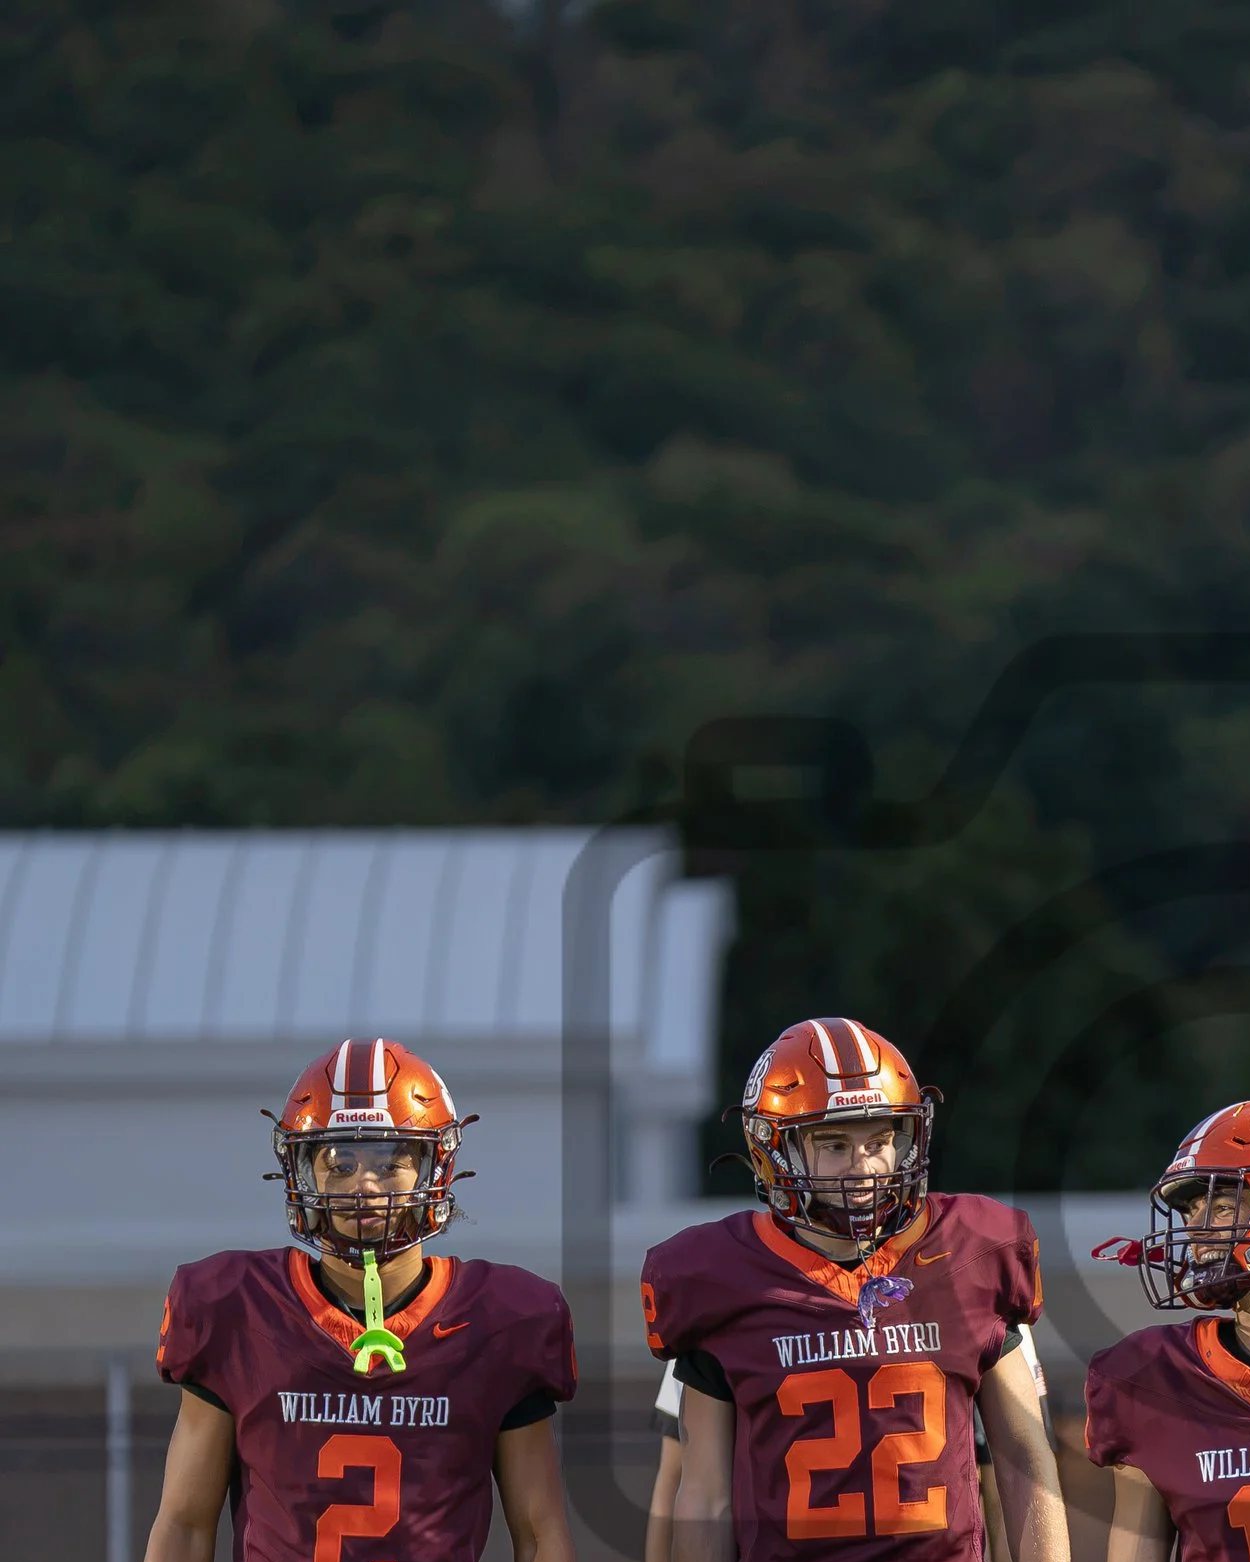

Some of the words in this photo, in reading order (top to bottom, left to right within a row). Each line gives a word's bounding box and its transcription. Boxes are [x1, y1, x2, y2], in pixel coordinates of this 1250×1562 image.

[835, 1092, 882, 1106] Riddell
[335, 1111, 384, 1124] Riddell
[772, 1327, 879, 1368] WILLIAM
[882, 1321, 942, 1354] BYRD
[277, 1391, 383, 1425] WILLIAM
[389, 1396, 450, 1426] BYRD
[776, 1360, 949, 1540] 22
